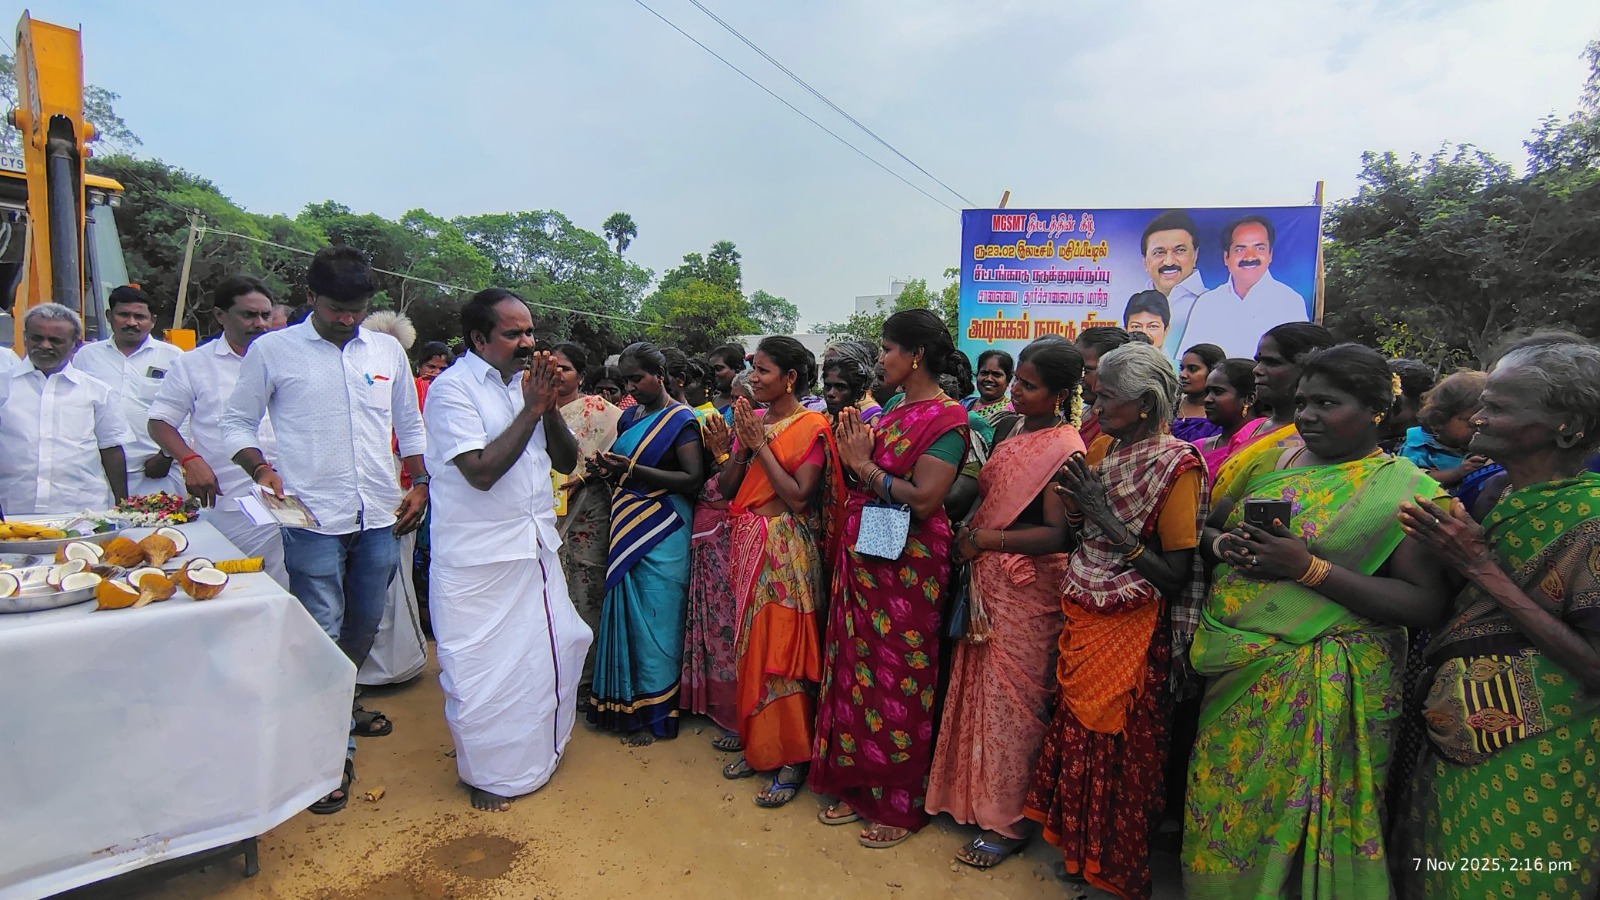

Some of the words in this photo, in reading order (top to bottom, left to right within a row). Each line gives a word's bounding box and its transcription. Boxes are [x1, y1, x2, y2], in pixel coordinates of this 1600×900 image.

[992, 214, 1027, 232] MGSMT
[1079, 213, 1095, 239] கீழ்
[1058, 239, 1108, 262] மதிப்பீட்டில்
[967, 311, 1030, 344] அடிக்கல்
